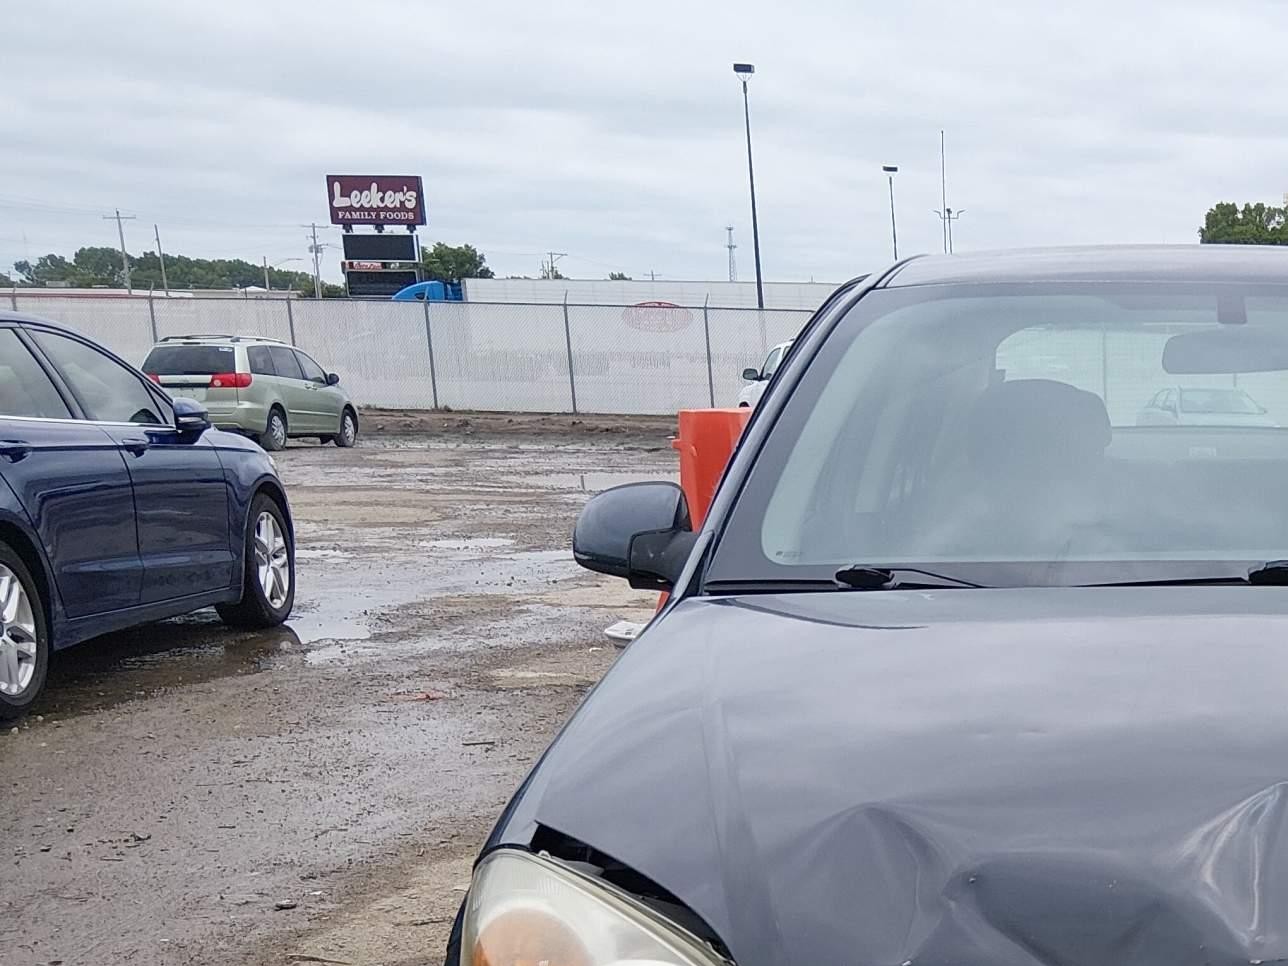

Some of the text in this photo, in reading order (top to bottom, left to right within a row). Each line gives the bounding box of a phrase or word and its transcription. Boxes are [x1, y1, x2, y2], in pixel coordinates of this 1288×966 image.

[333, 181, 417, 209] Leeker's
[338, 211, 415, 220] FAMILY FOODS
